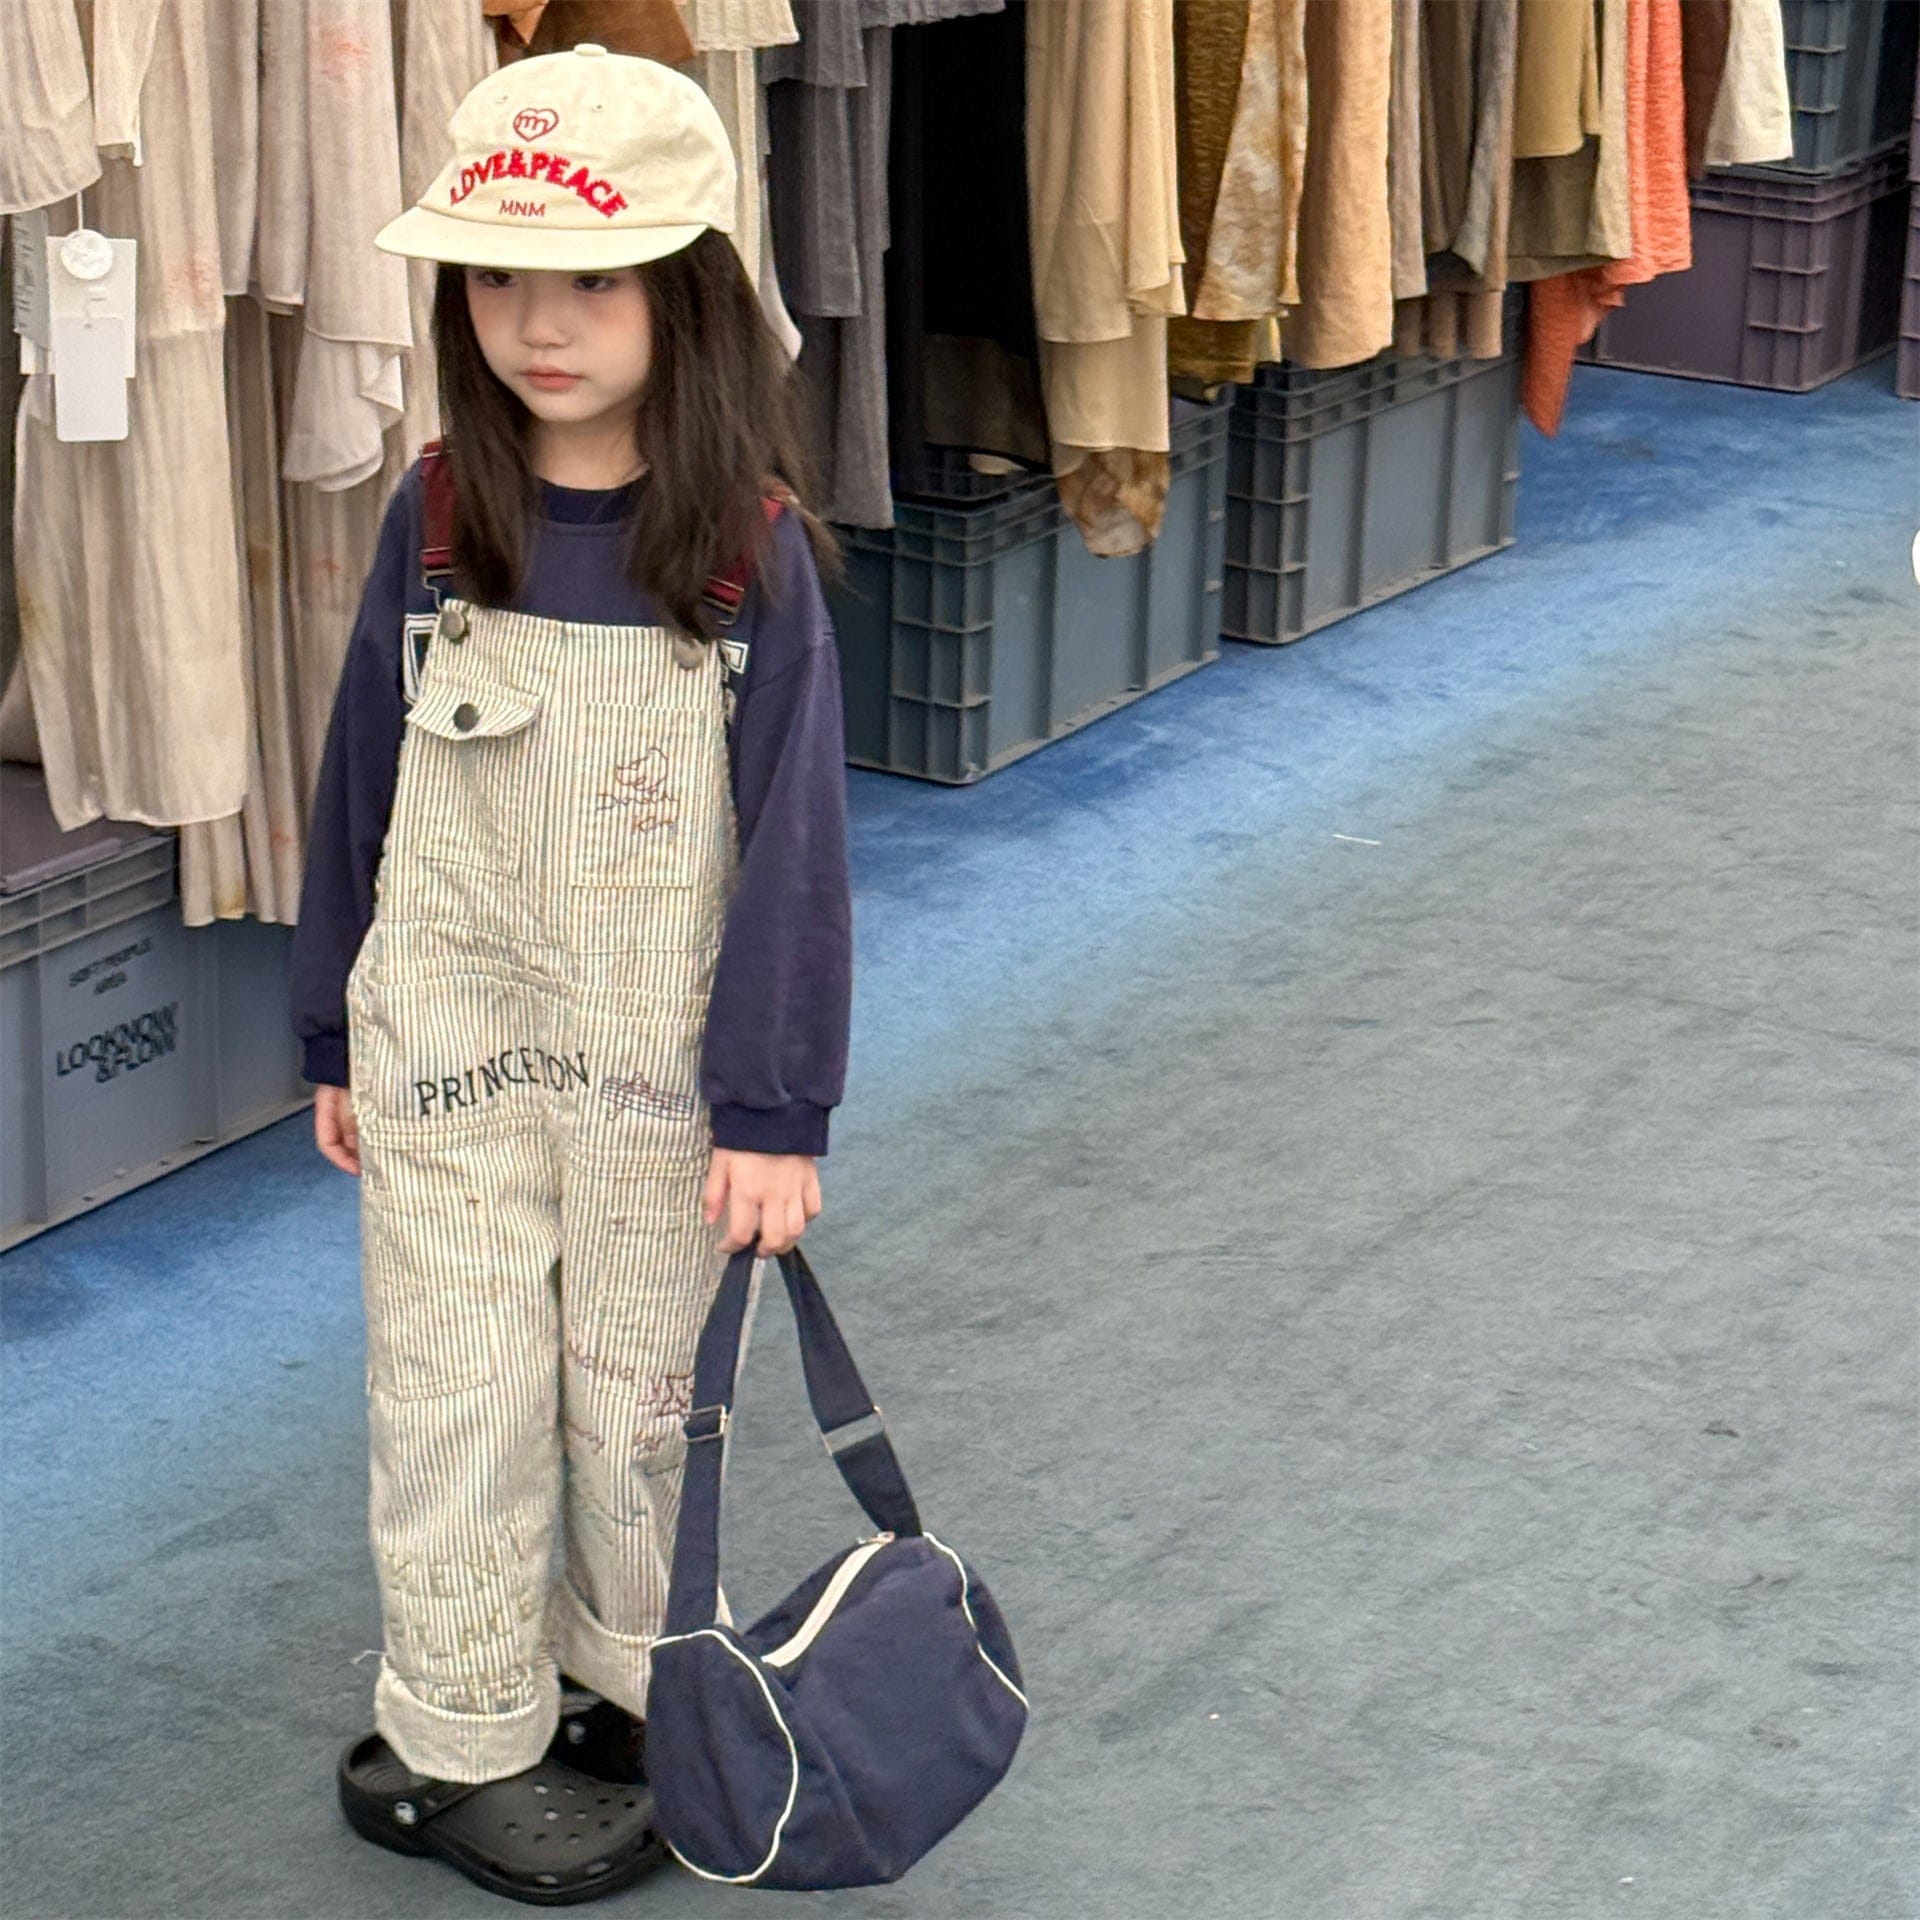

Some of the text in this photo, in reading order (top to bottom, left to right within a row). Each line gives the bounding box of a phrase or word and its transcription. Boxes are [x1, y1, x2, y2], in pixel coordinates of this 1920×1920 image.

[450, 148, 628, 218] LOVE&PEACE
[499, 200, 547, 217] MNM
[413, 1047, 590, 1116] PRINCETON
